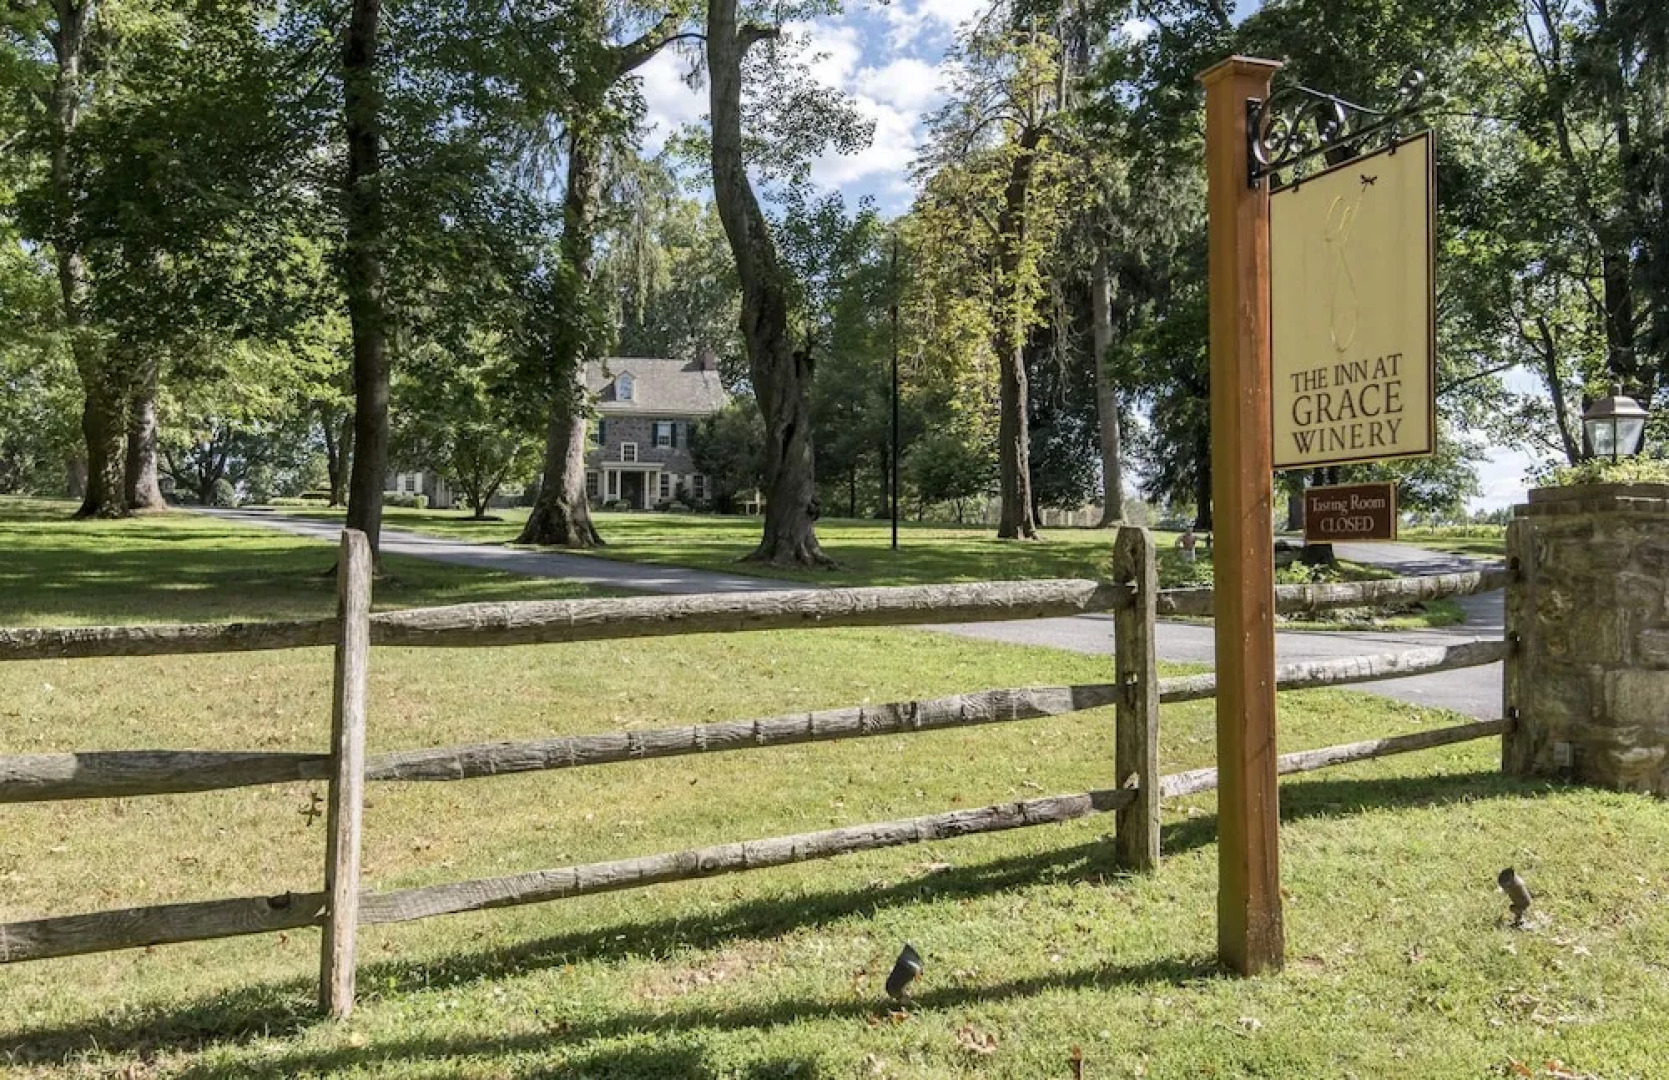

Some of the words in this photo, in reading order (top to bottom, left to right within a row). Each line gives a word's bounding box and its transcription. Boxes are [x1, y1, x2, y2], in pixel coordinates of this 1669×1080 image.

[1290, 367, 1328, 393] THE
[1333, 359, 1368, 386] INN
[1372, 353, 1403, 380] AT
[1292, 380, 1403, 426] GRACE
[1291, 418, 1403, 454] WINERY
[1310, 496, 1349, 516] Tasting
[1350, 493, 1386, 510] Room
[1321, 515, 1375, 533] CLOSED
